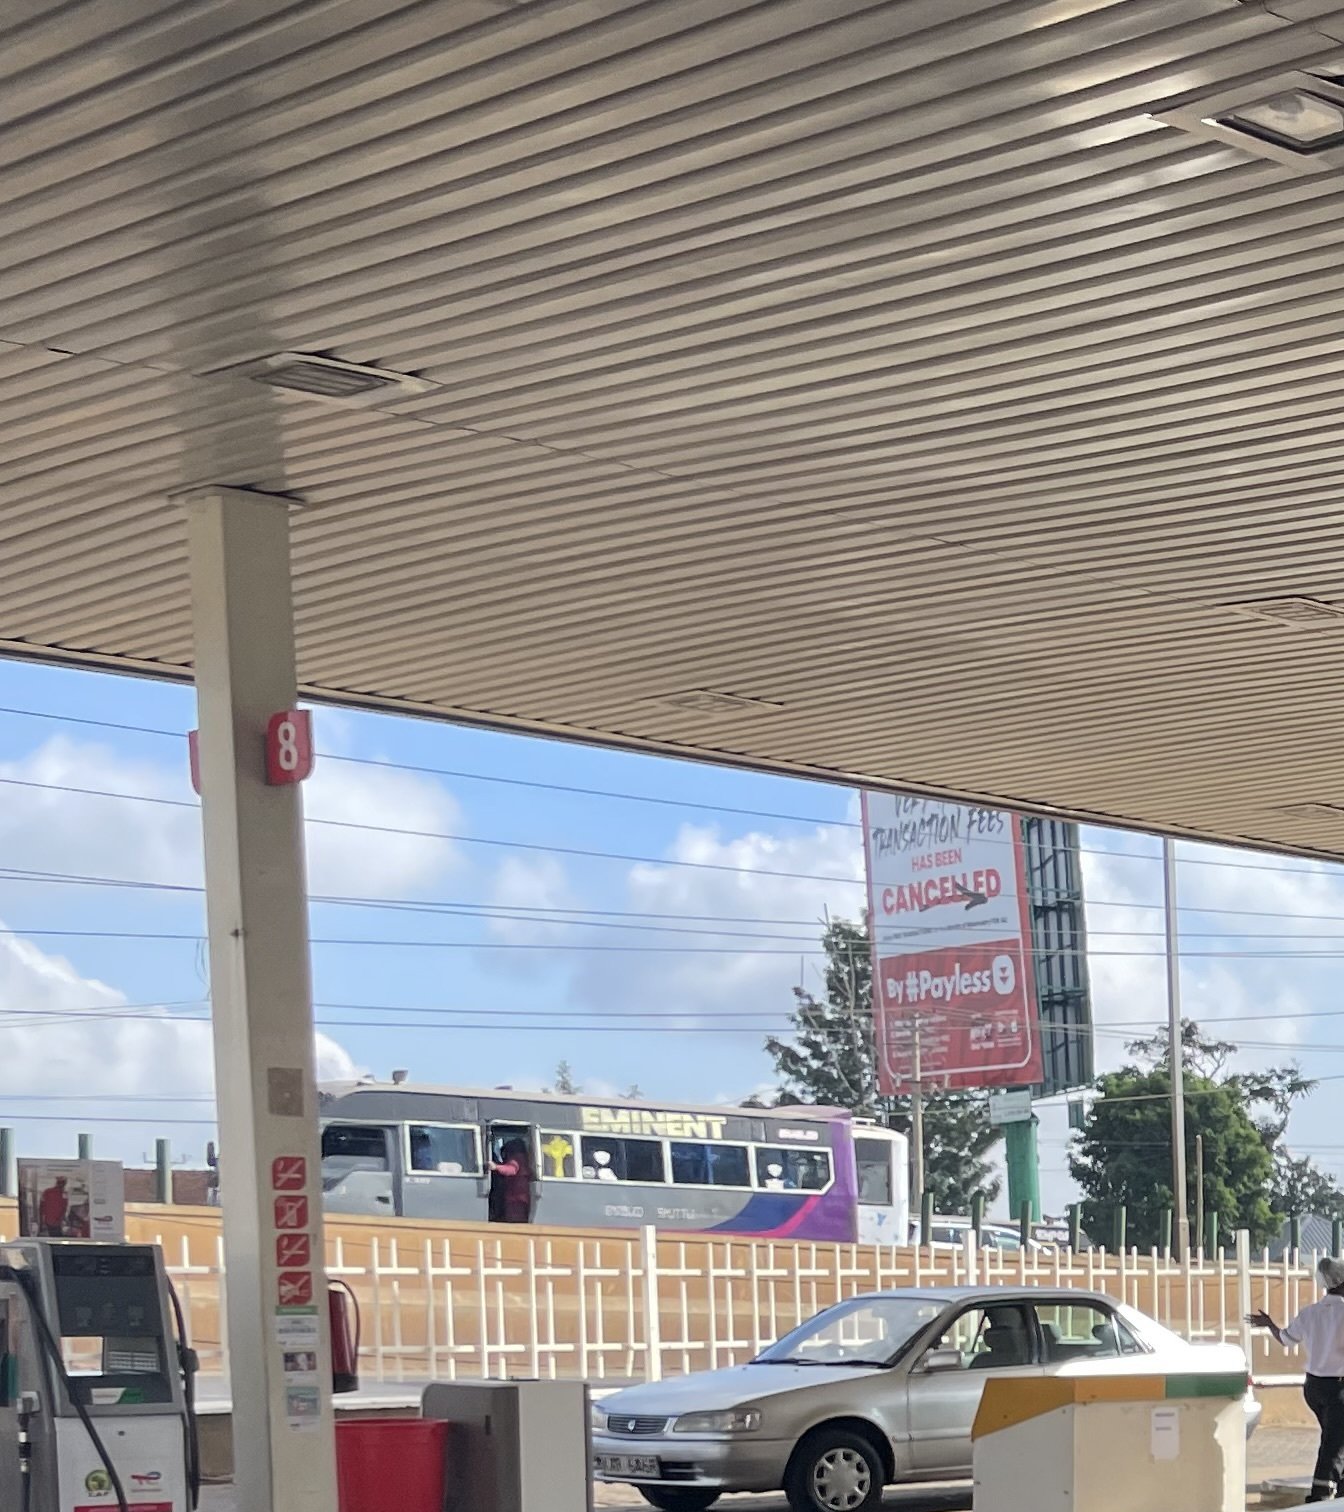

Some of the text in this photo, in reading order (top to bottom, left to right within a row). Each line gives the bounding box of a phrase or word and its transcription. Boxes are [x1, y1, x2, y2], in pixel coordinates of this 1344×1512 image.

[277, 721, 298, 770] 8
[872, 807, 1004, 860] TRANSACTION FEES
[911, 848, 962, 872] HAS BEEN
[886, 962, 992, 1004] By #Payless
[581, 1106, 727, 1140] EMINENT
